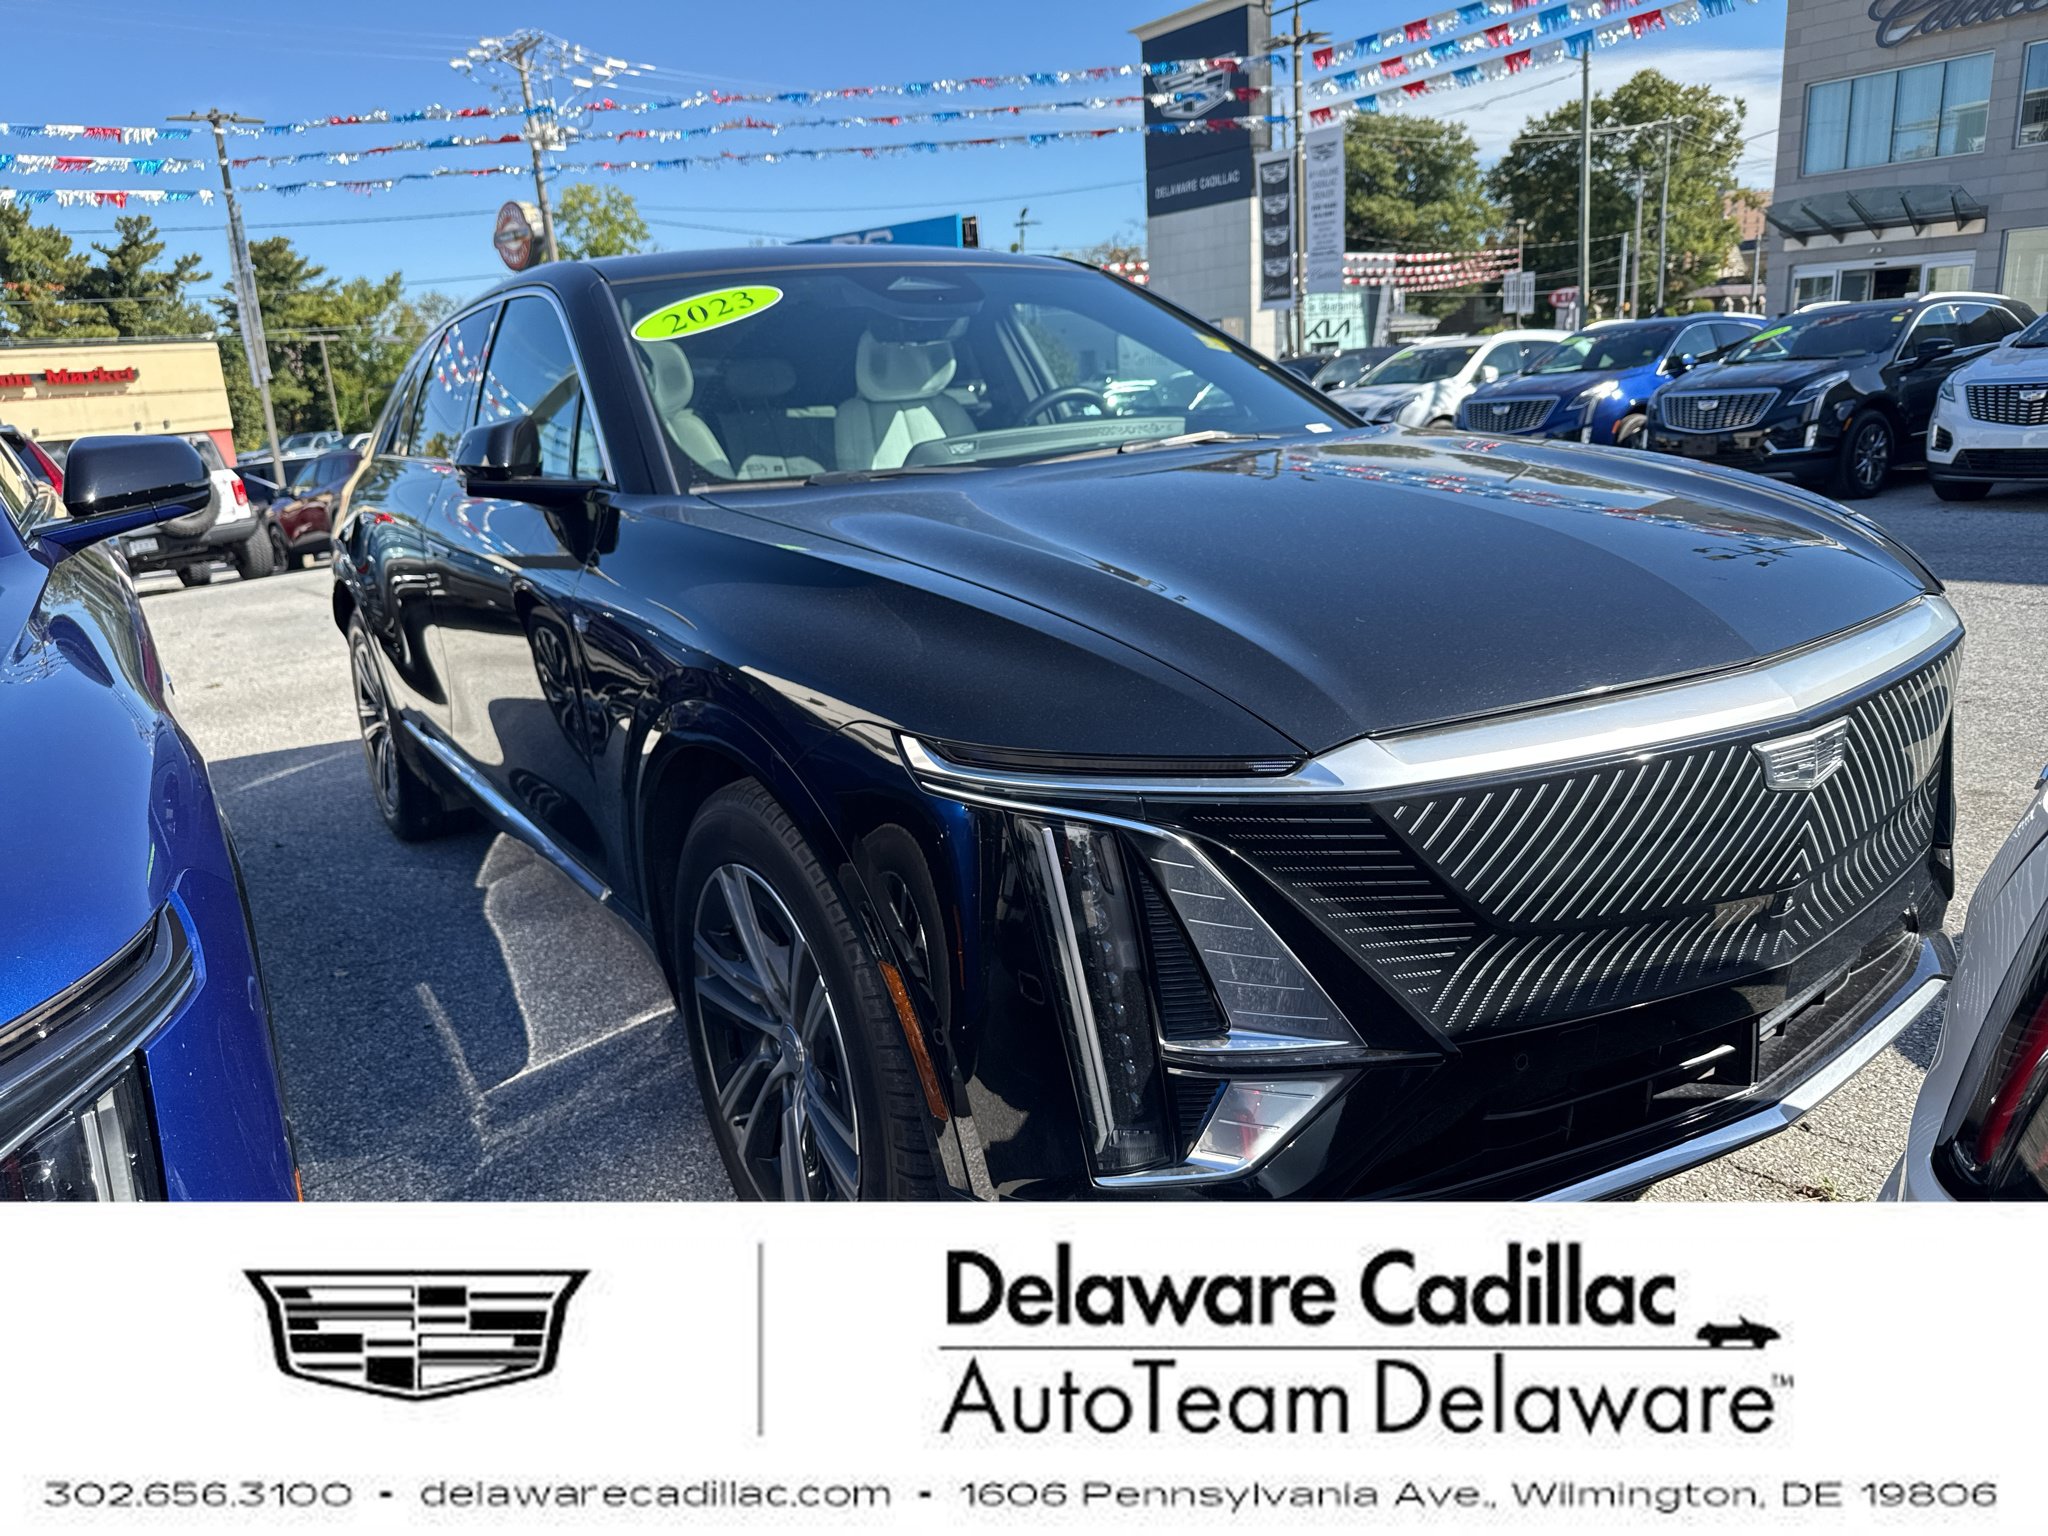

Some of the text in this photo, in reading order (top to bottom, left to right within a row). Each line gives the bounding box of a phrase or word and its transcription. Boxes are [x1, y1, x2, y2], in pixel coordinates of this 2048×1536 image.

[1155, 168, 1241, 200] DELAWARE CADILLAC
[662, 291, 754, 334] 2023
[44, 366, 135, 385] Market
